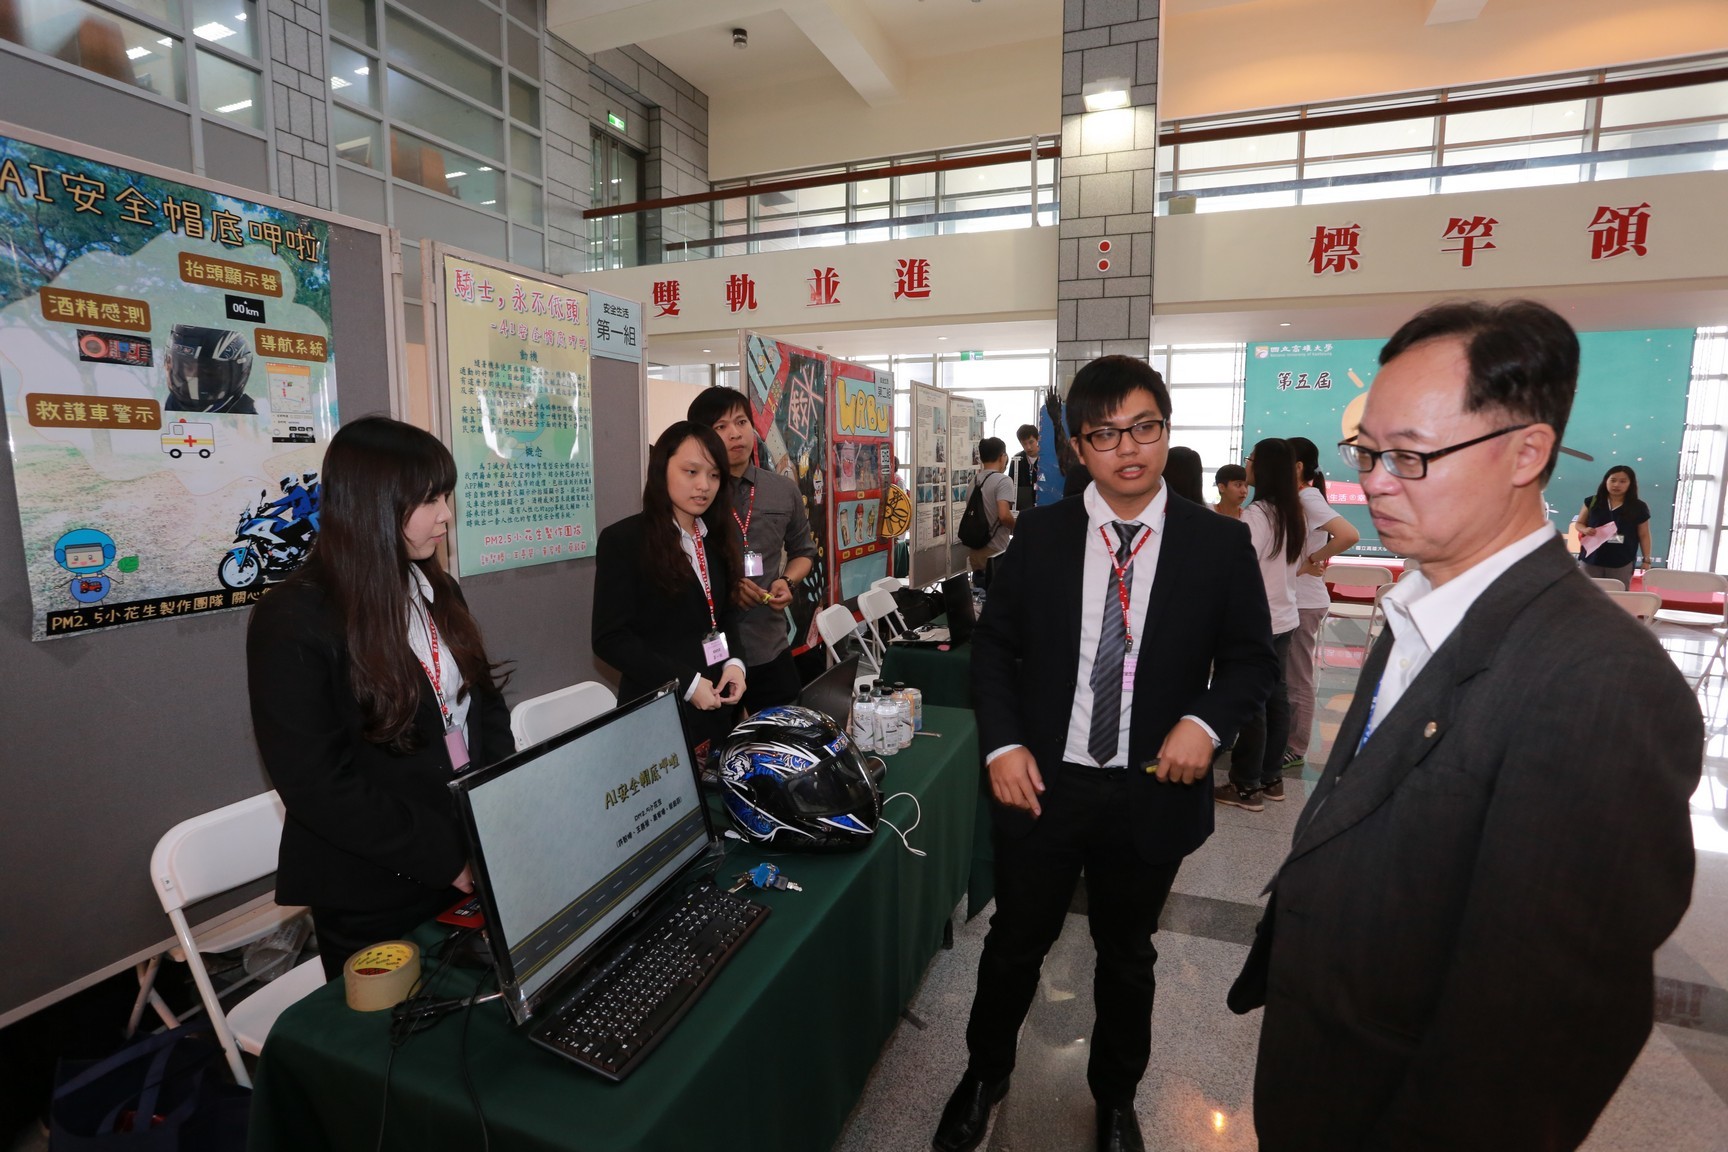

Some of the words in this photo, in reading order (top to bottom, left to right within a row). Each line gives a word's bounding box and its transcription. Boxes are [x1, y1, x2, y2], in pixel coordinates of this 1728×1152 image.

[184, 258, 279, 292] 抬頭顯示器
[48, 294, 145, 325] 酒精感測
[232, 302, 245, 315] 00
[246, 303, 259, 317] km
[260, 334, 324, 357] 導航系統
[596, 319, 636, 347] 第一組
[1276, 370, 1333, 391] 第五屆
[35, 400, 155, 424] 救護車警示
[837, 377, 889, 435] WABU
